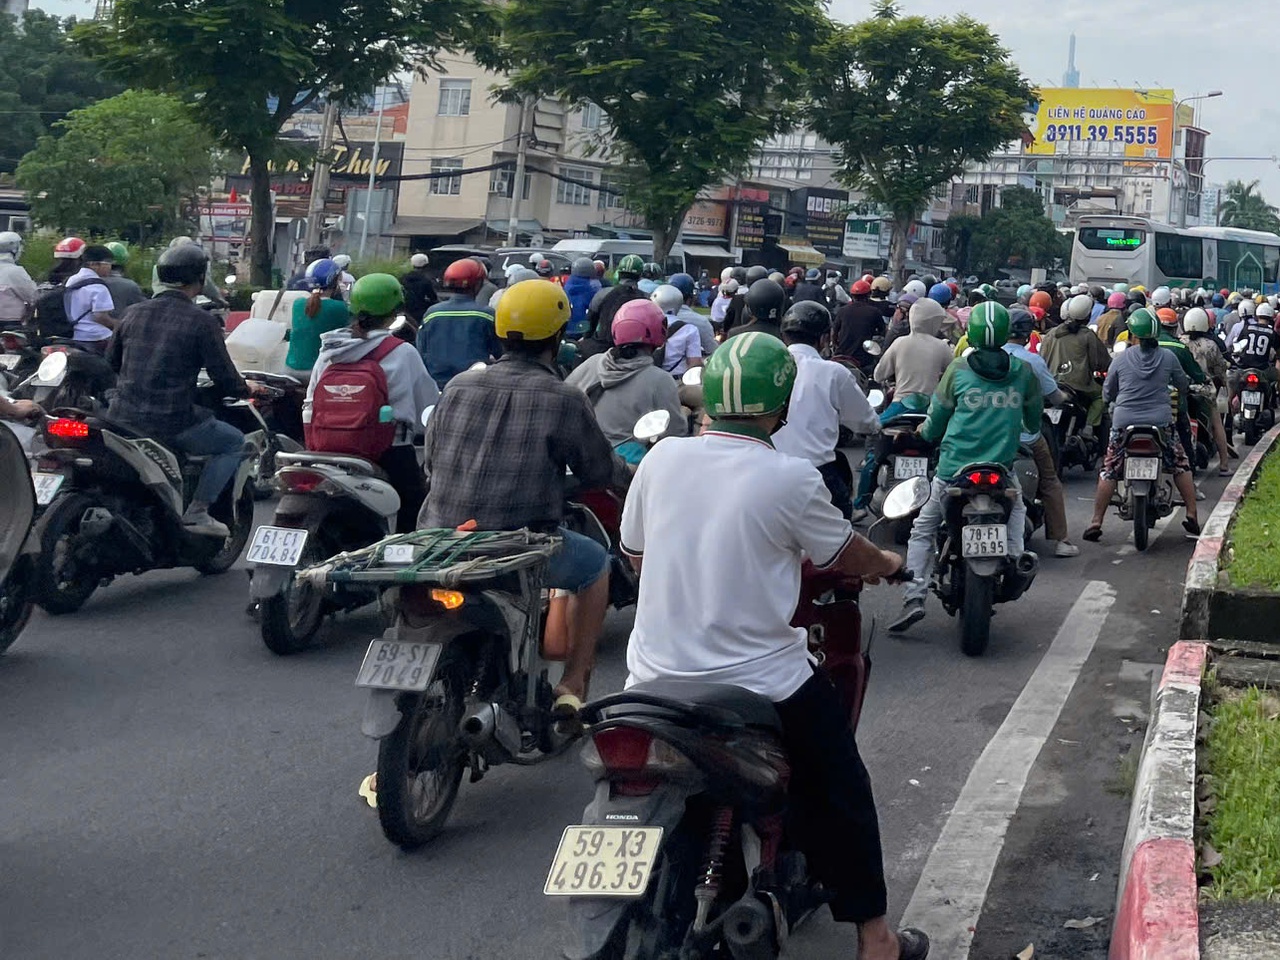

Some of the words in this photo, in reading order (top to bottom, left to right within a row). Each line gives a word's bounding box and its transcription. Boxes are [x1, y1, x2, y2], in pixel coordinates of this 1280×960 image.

[1048, 105, 1070, 119] LIÊN
[1073, 106, 1086, 122] HỆ
[1089, 106, 1123, 120] QUẢNG
[1126, 106, 1146, 120] CÁO
[1246, 333, 1270, 356] 19
[964, 386, 1022, 409] Grab
[262, 531, 298, 546] 61-C1
[573, 830, 647, 858] 59-X3
[553, 861, 647, 890] 496.35
